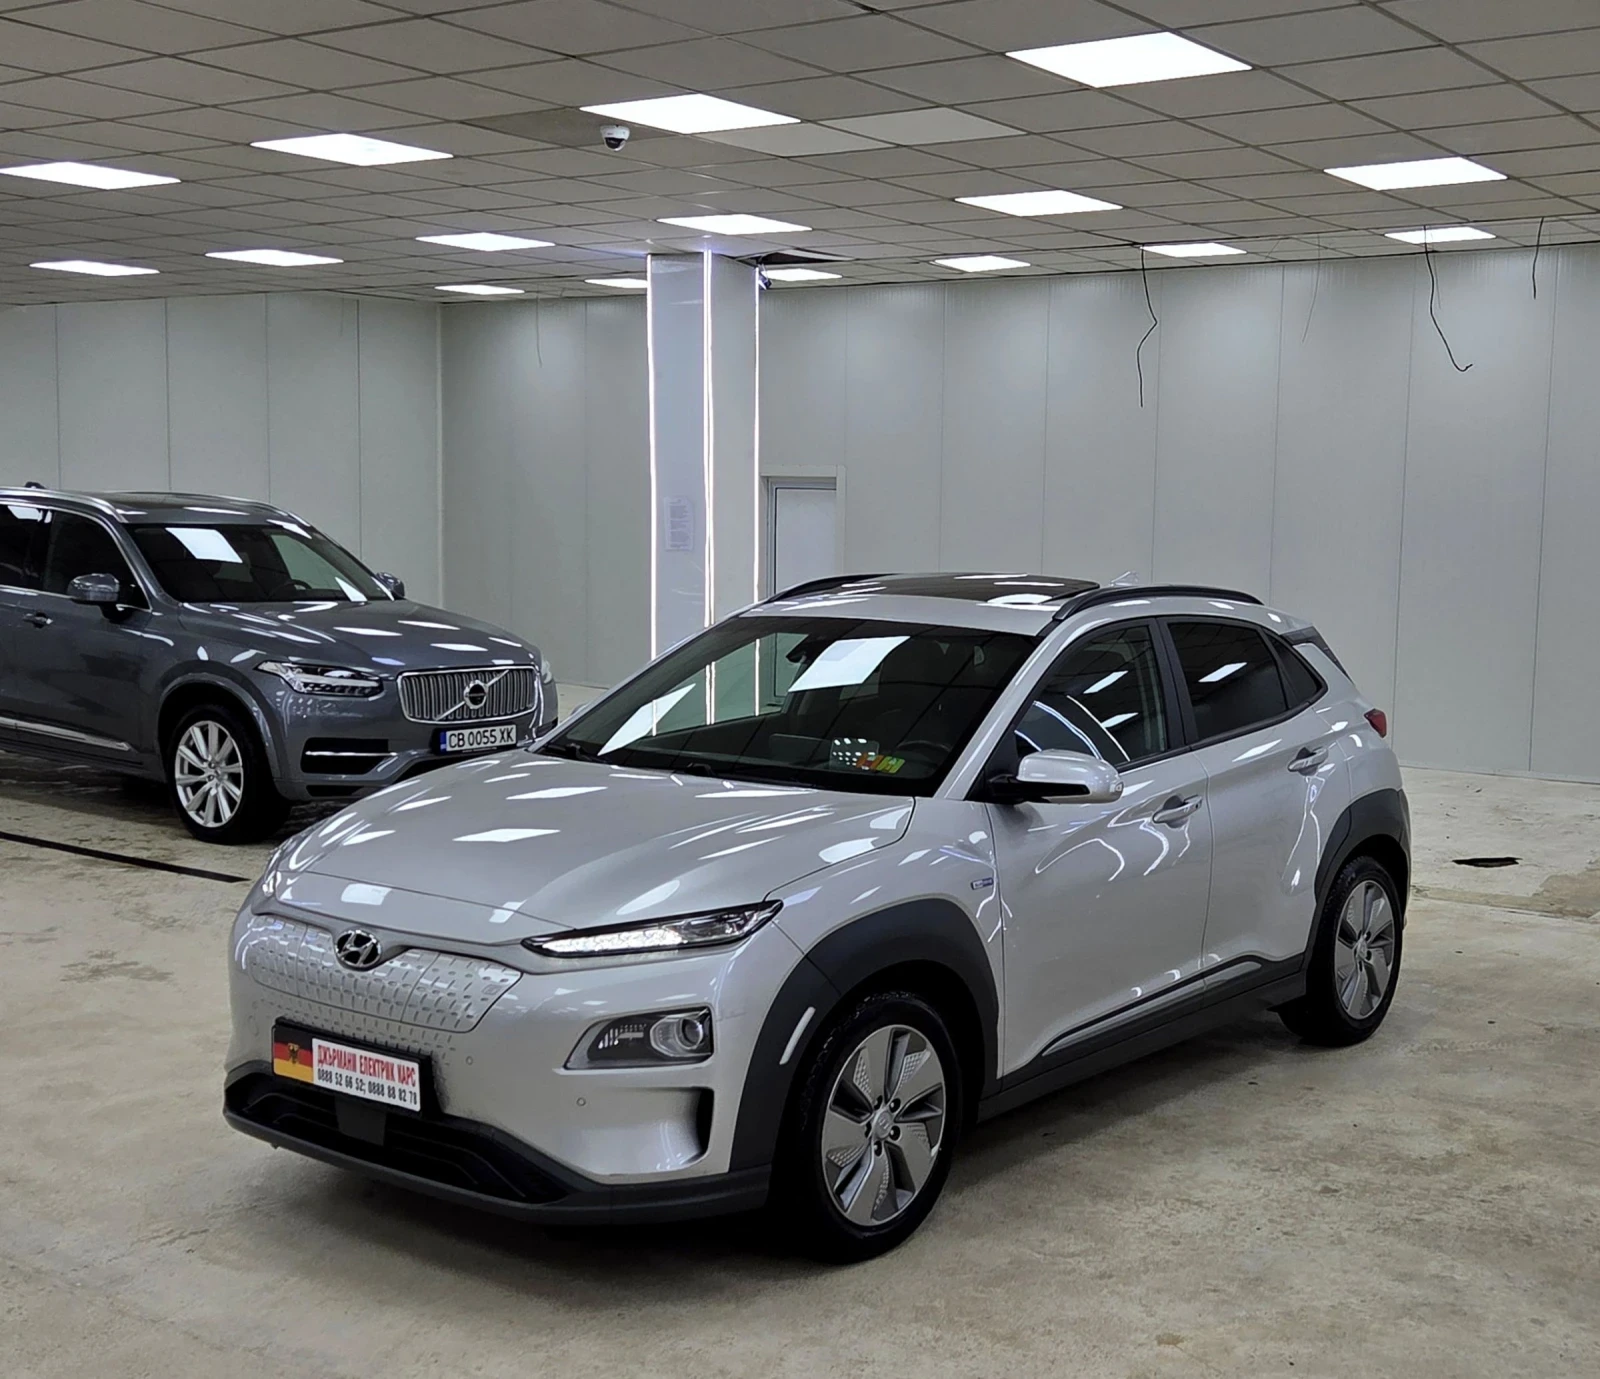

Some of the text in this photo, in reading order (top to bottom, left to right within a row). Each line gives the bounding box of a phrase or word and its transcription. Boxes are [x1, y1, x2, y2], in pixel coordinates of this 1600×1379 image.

[449, 726, 514, 748] CB 0055 XK
[317, 1067, 333, 1084] 0888
[335, 1072, 343, 1086] 52
[368, 1080, 385, 1097] 0888
[360, 1054, 396, 1082] ЕЛЕКТРИК
